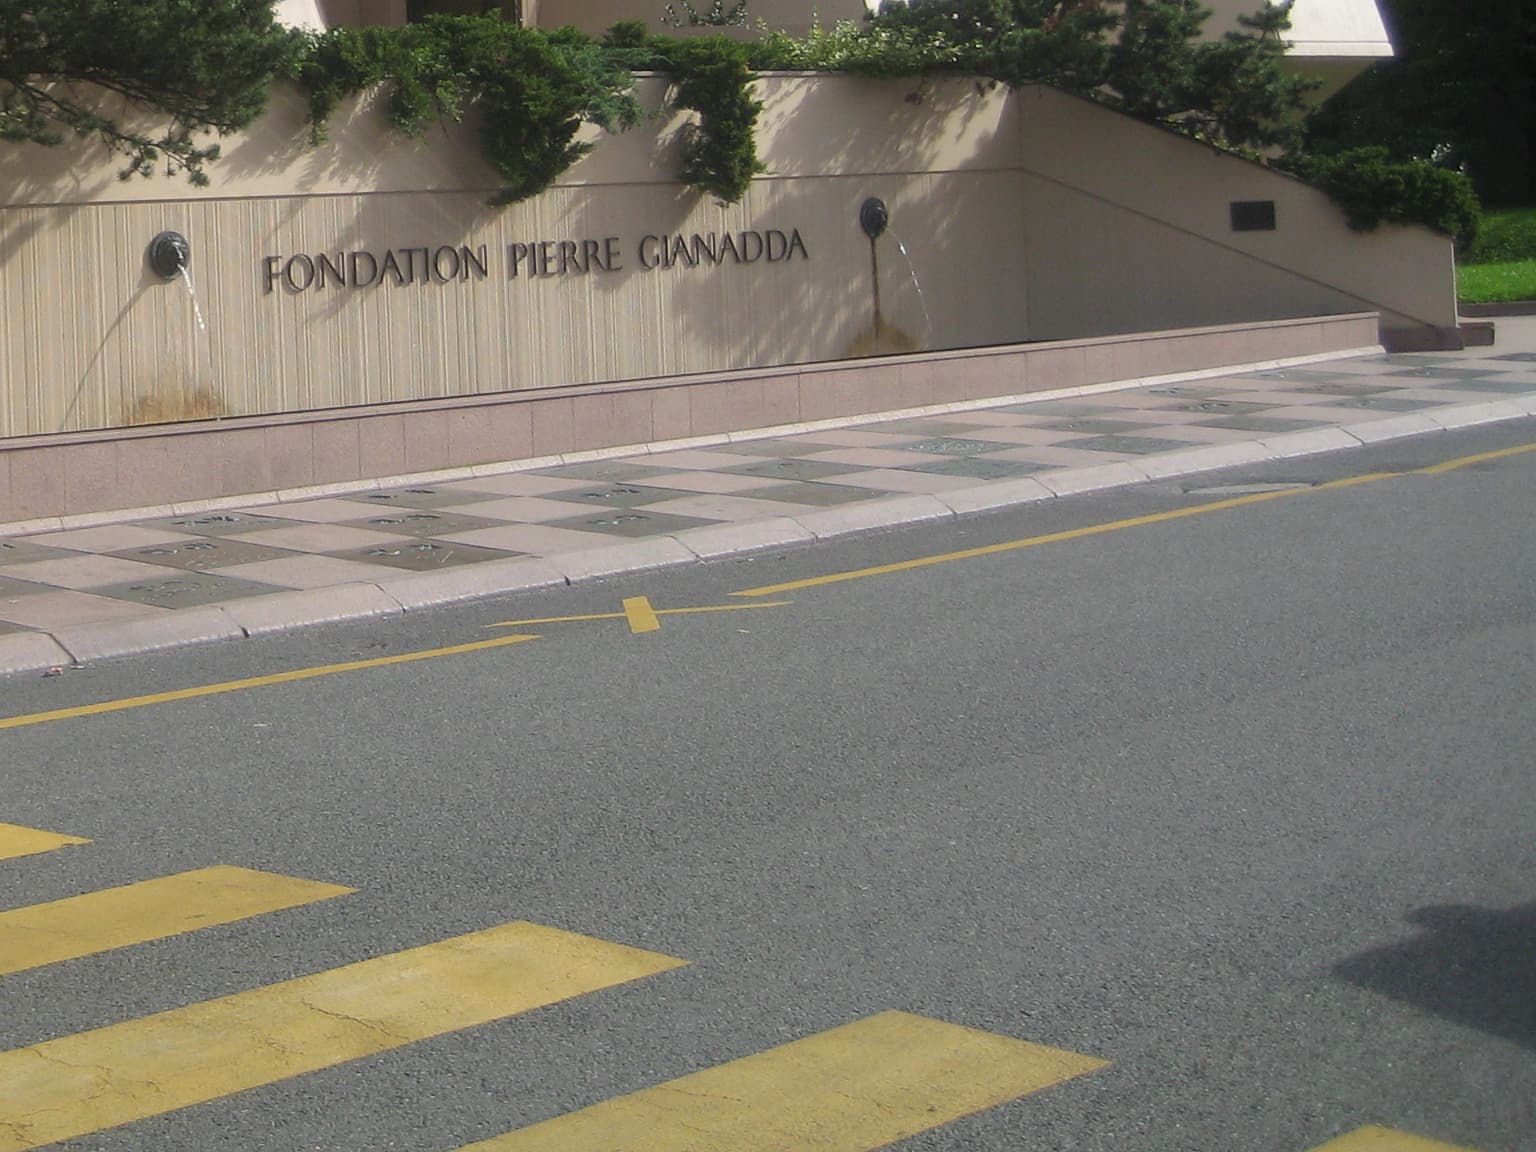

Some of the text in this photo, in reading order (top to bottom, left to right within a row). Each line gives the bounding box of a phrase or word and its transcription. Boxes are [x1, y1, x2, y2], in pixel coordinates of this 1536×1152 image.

[266, 228, 809, 292] FONDATION PIERRE GIANADDA
